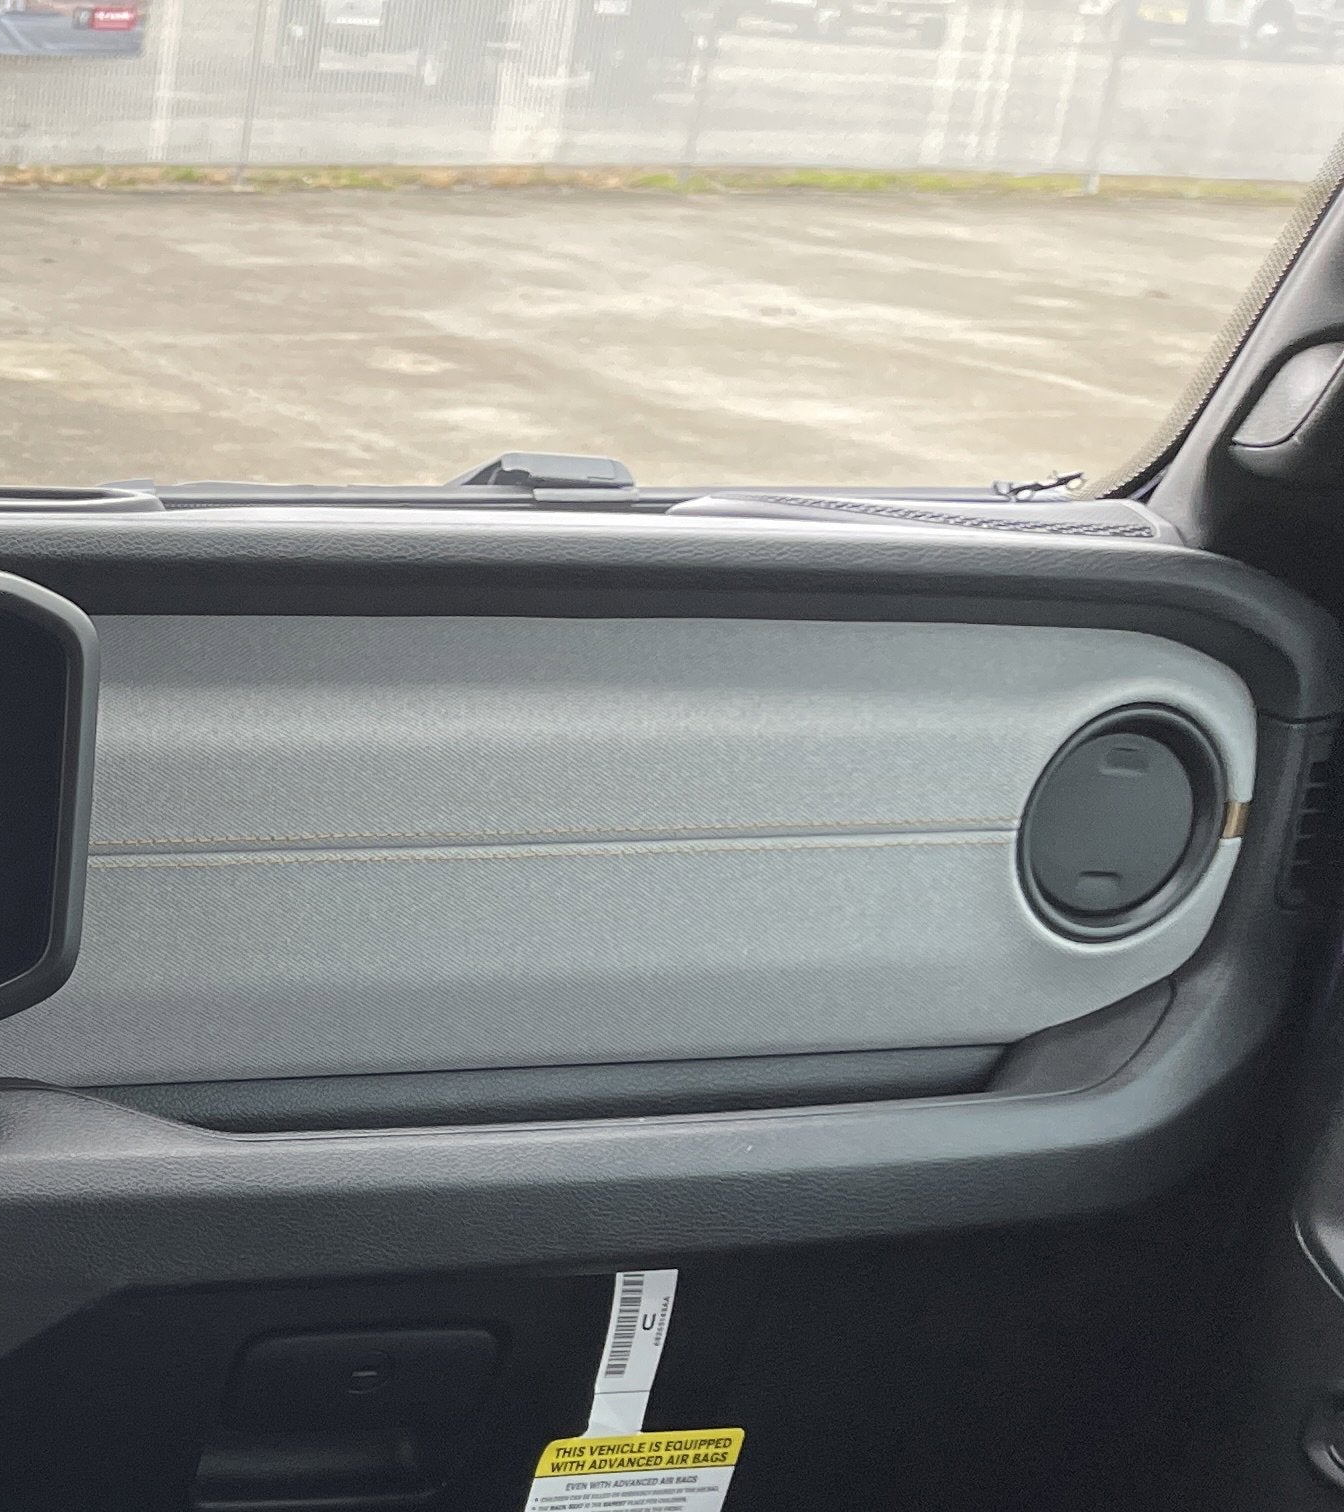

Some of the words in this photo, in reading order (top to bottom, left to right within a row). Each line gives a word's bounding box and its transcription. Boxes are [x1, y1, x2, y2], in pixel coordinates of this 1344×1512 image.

[555, 1446, 585, 1459] THIS
[589, 1442, 645, 1457] VEHICLE
[649, 1441, 661, 1453] IS
[664, 1437, 732, 1453] EQUIPPED
[551, 1461, 585, 1473] WITH
[587, 1455, 662, 1471] ADVANCED
[666, 1454, 689, 1466] AIR
[692, 1451, 727, 1465] BAGS
